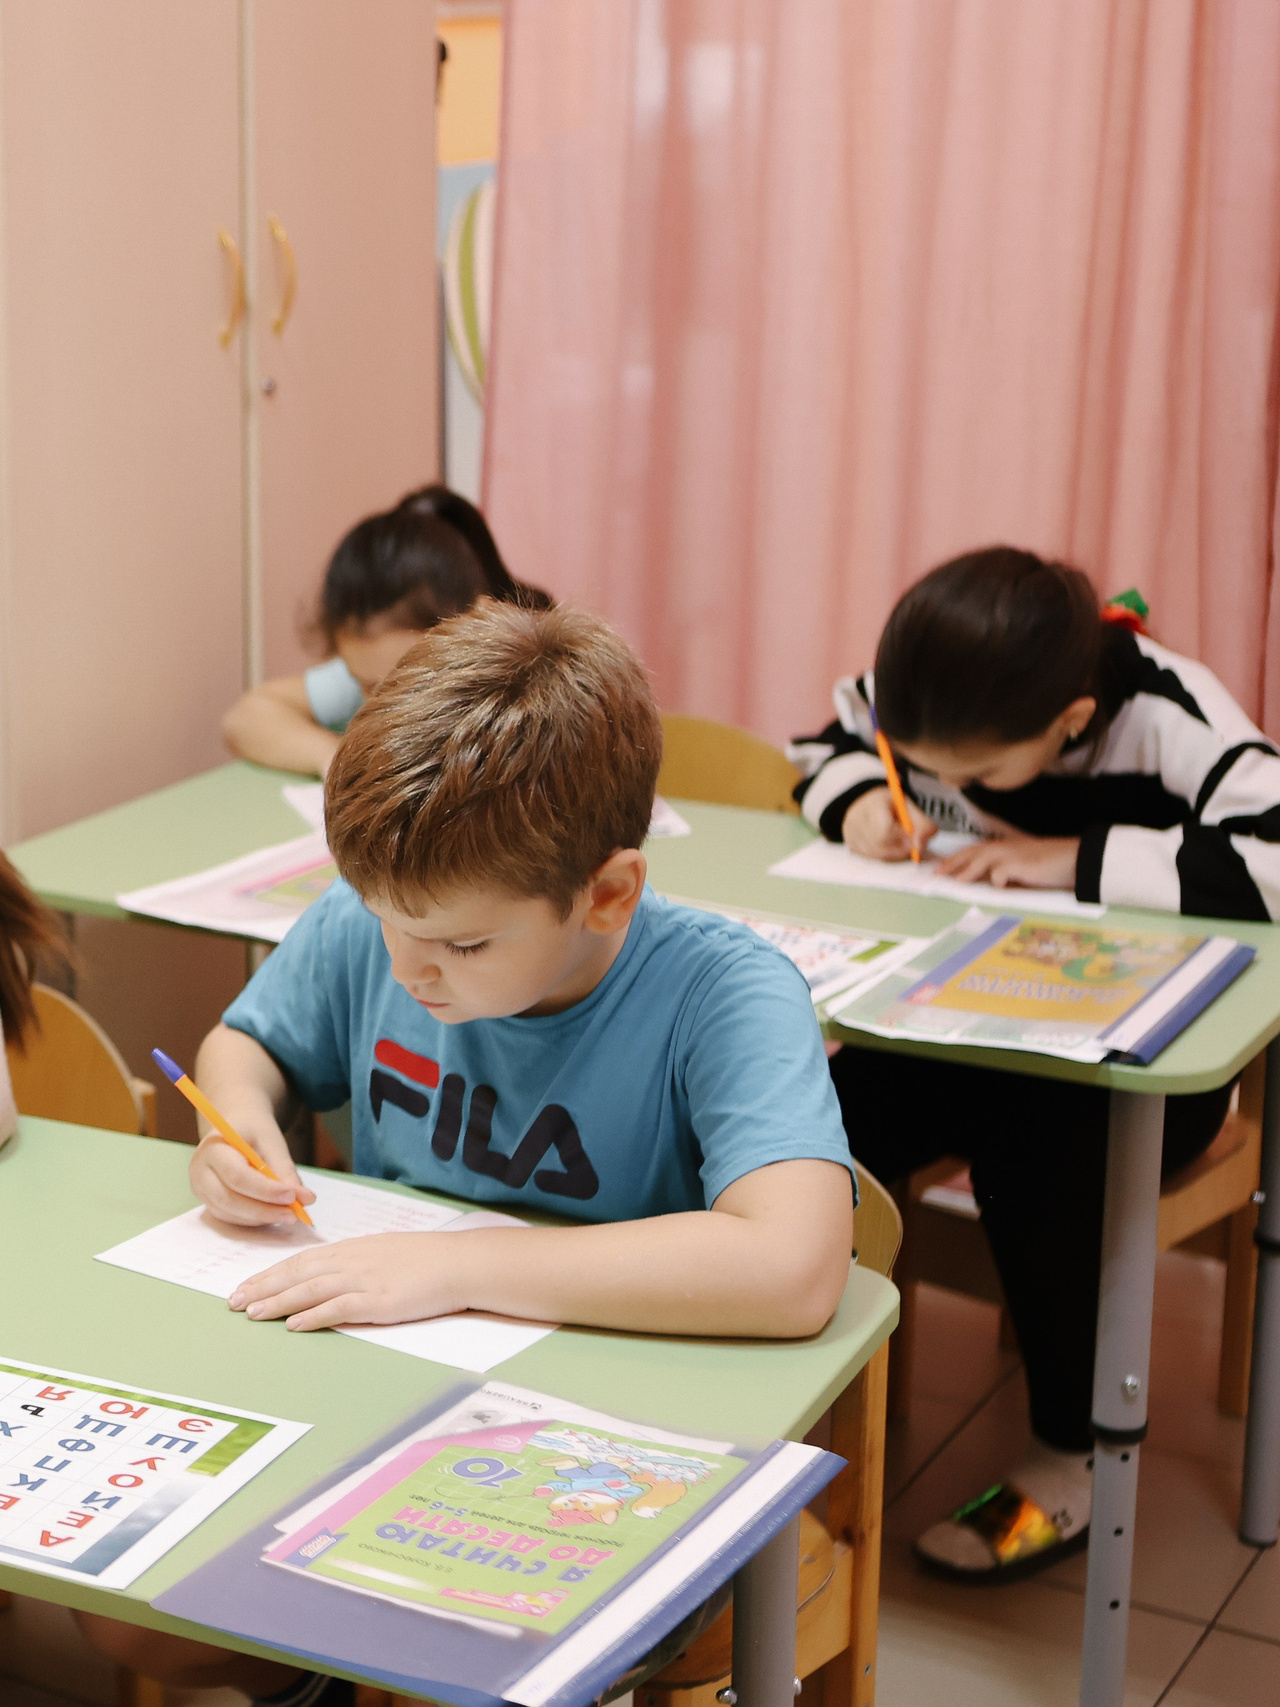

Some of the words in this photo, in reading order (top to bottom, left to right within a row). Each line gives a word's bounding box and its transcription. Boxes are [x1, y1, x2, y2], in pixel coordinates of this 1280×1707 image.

[369, 1038, 600, 1201] FILA
[35, 1385, 74, 1401] Я
[99, 1400, 150, 1420] Ю
[177, 1418, 214, 1433] Э
[57, 1438, 96, 1452] Ф
[145, 1433, 199, 1454] Ш
[33, 1455, 72, 1473] П
[129, 1456, 166, 1471] У
[452, 1457, 525, 1489] 10
[9, 1472, 47, 1492] К
[107, 1473, 144, 1489] О
[80, 1490, 122, 1512] Й
[57, 1510, 95, 1529] Е
[39, 1529, 75, 1548] А
[392, 1505, 547, 1555] ДЕСЯТИ
[375, 1522, 549, 1577] СЧИТАЮ
[547, 1545, 615, 1567] ДО
[557, 1566, 594, 1584] Я
